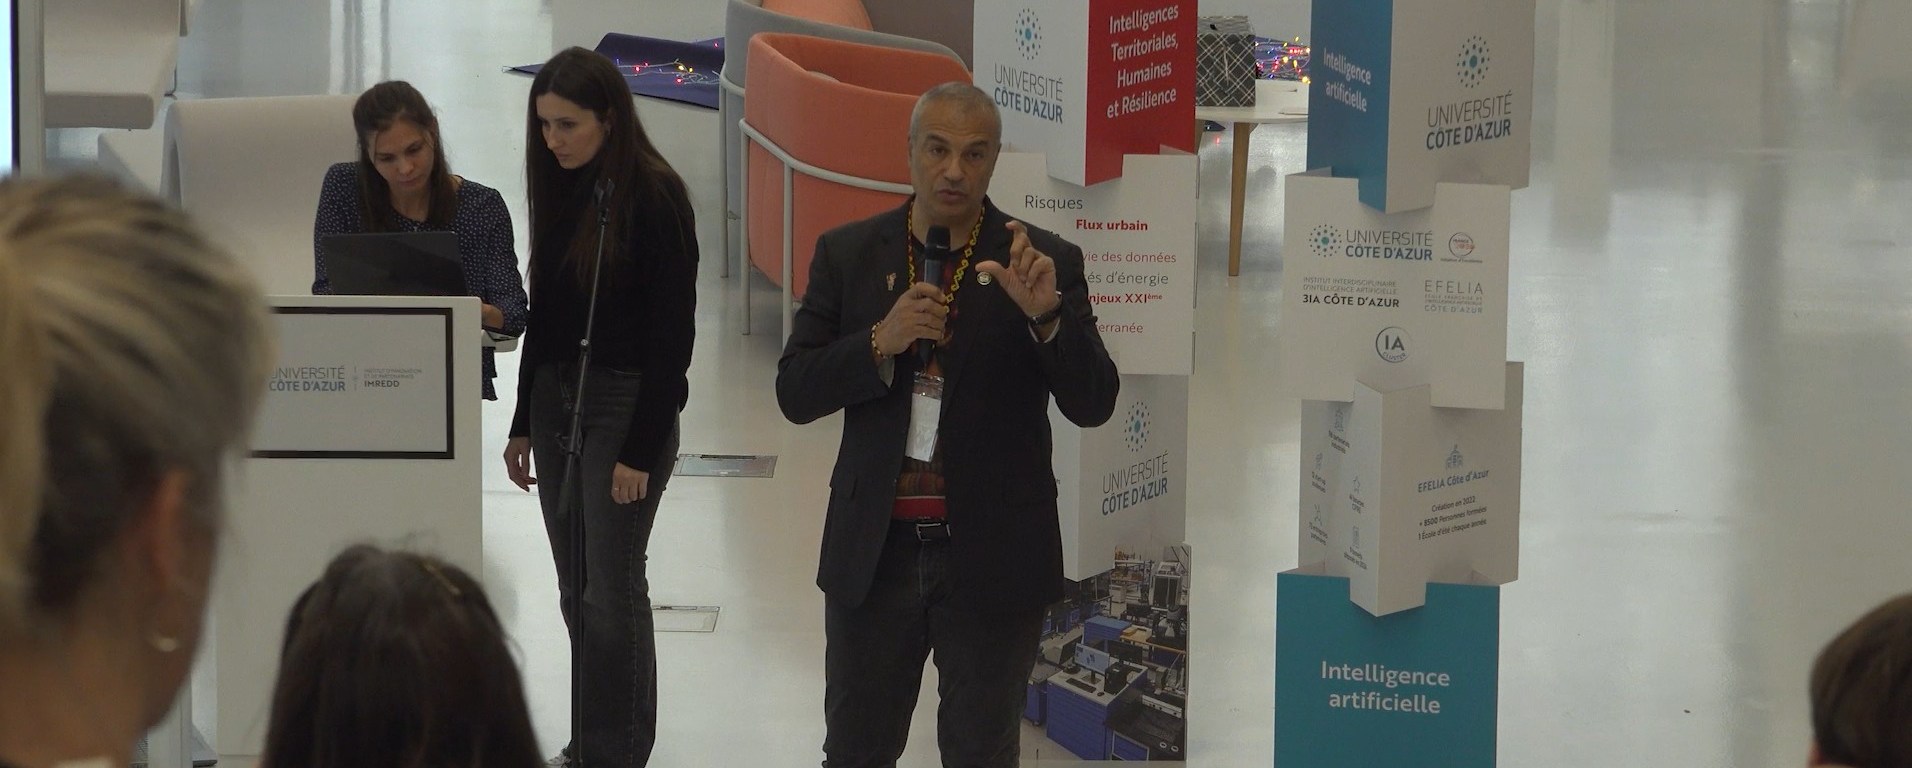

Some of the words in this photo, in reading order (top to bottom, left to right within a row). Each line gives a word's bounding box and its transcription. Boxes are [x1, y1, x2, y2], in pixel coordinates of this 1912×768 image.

[1109, 4, 1179, 34] Intelligences
[1110, 33, 1179, 62] Territoriales,
[1117, 61, 1172, 88] Humaines
[1323, 48, 1371, 86] Intelligence
[994, 63, 1063, 102] UNIVERSITÉ
[994, 86, 1022, 112] CÔTE
[1024, 93, 1063, 124] D'AZUR
[1107, 102, 1119, 118] et
[1122, 86, 1177, 116] Résilience
[1326, 80, 1368, 112] artificielle
[1428, 90, 1512, 128] UNIVERSITÉ
[1426, 126, 1461, 150] CÔTE
[1464, 118, 1512, 142] D'AZUR
[1024, 194, 1084, 212] Risques
[1076, 219, 1104, 230] Flux
[1106, 220, 1148, 231] urbain
[1346, 230, 1433, 247] UNIVERSITÉ
[1101, 252, 1122, 262] des
[1125, 252, 1177, 263] données
[1345, 244, 1381, 258] CÔTE
[1384, 246, 1433, 261] D'AZUR
[1086, 272, 1102, 283] és
[1106, 270, 1168, 287] d'énergie
[1424, 280, 1482, 294] EFELIA
[1088, 292, 1121, 305] njeux
[1302, 294, 1320, 304] 3IA
[1324, 292, 1354, 306] CÔTE
[1357, 296, 1400, 308] D'AZUR
[1097, 322, 1144, 333] erranée
[1385, 334, 1404, 351] IA
[268, 379, 300, 392] CÔTE
[302, 380, 346, 392] D'AZUR
[1102, 450, 1169, 494] UNIVERSITÉ
[1418, 478, 1445, 492] EFELIA
[1447, 475, 1464, 486] Côte
[1466, 470, 1489, 482] d'Azur
[1102, 493, 1130, 516] CÔTE
[1131, 478, 1168, 506] D'AZUR
[1432, 502, 1454, 512] Création
[1321, 660, 1450, 688] Intelligence
[1328, 692, 1441, 714] artificielle
